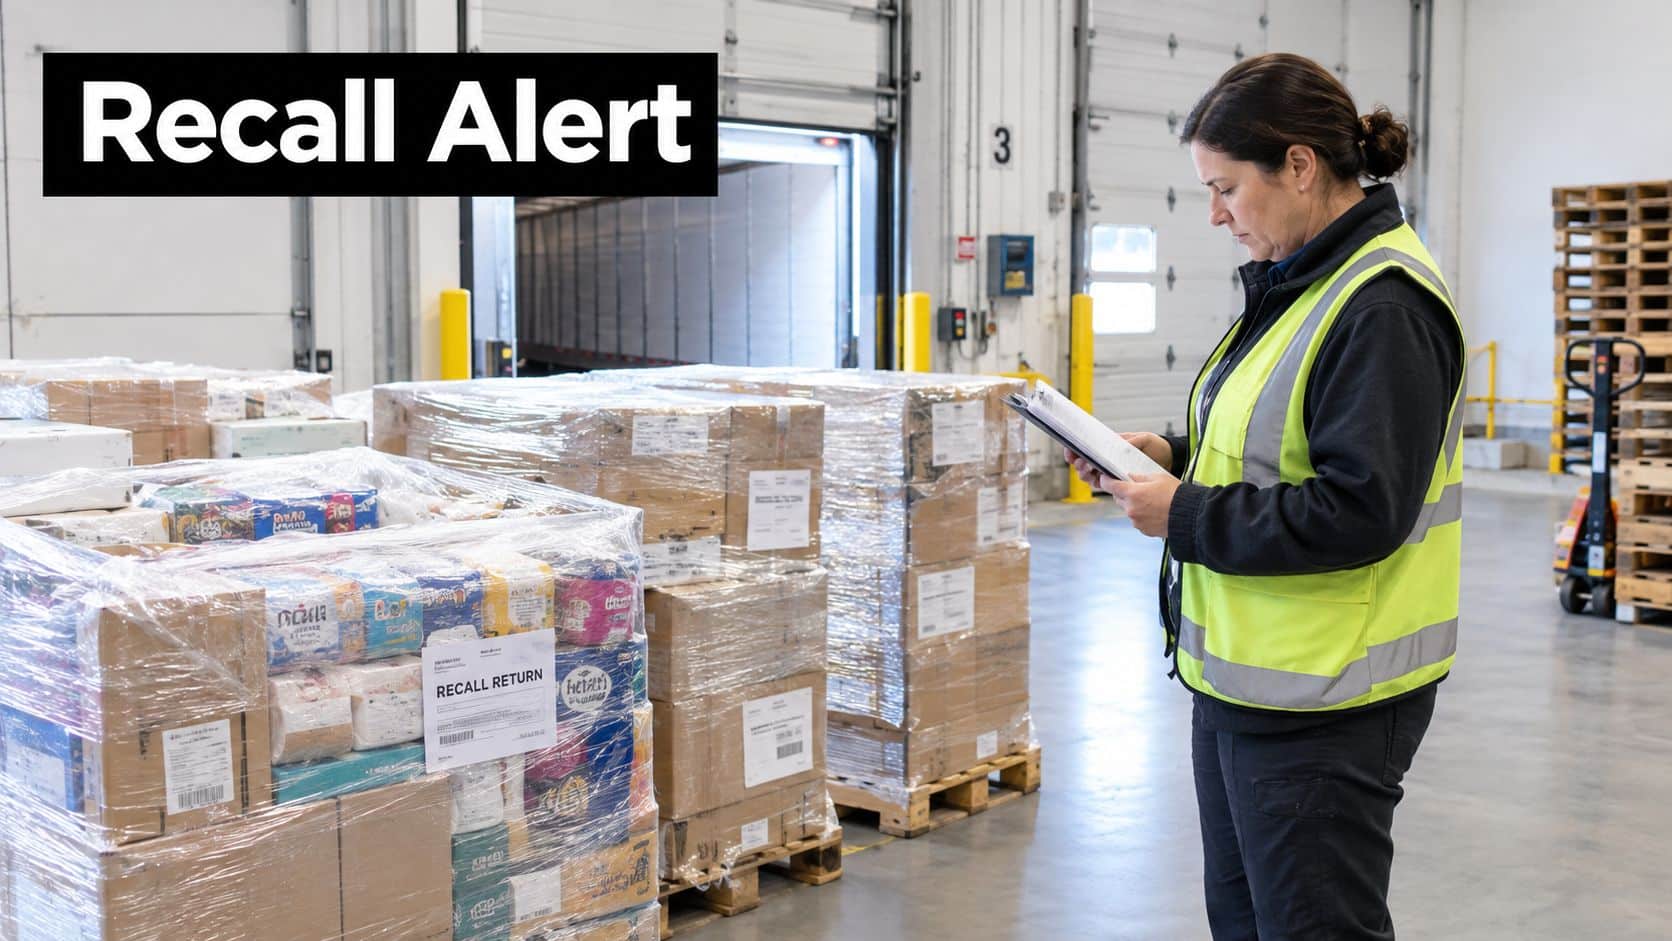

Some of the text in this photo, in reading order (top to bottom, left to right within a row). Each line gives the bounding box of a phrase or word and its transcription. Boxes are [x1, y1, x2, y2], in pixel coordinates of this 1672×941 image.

[993, 126, 1012, 165] 3
[436, 678, 489, 699] RECALL
[492, 668, 543, 689] RETURN
